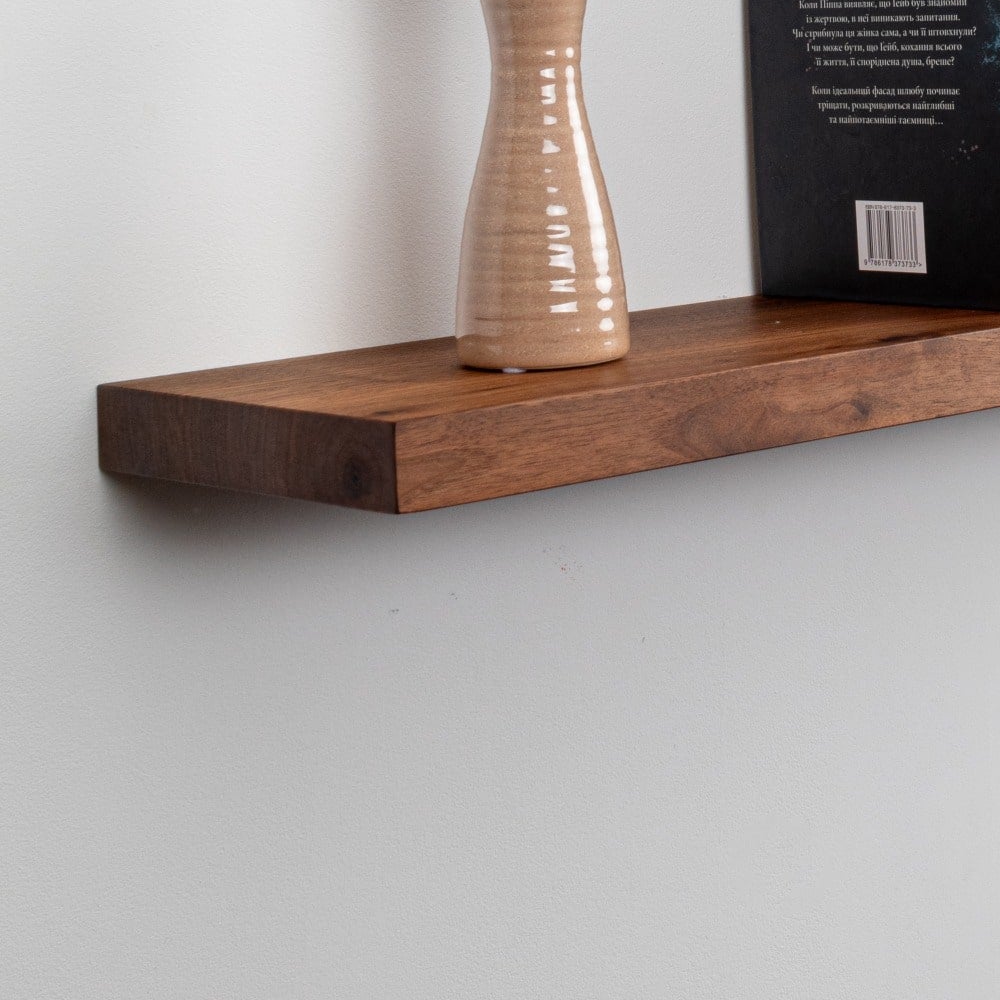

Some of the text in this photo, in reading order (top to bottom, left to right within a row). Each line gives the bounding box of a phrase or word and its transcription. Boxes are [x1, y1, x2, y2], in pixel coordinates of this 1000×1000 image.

[878, 1, 891, 10] що
[806, 13, 812, 23] із
[857, 12, 869, 22] неї
[792, 28, 803, 38] Чи
[845, 30, 855, 39] ця
[908, 29, 919, 37] чи
[920, 27, 926, 37] її
[811, 44, 820, 52] чи
[866, 44, 878, 53] що
[815, 56, 821, 66] її
[849, 56, 855, 66] її
